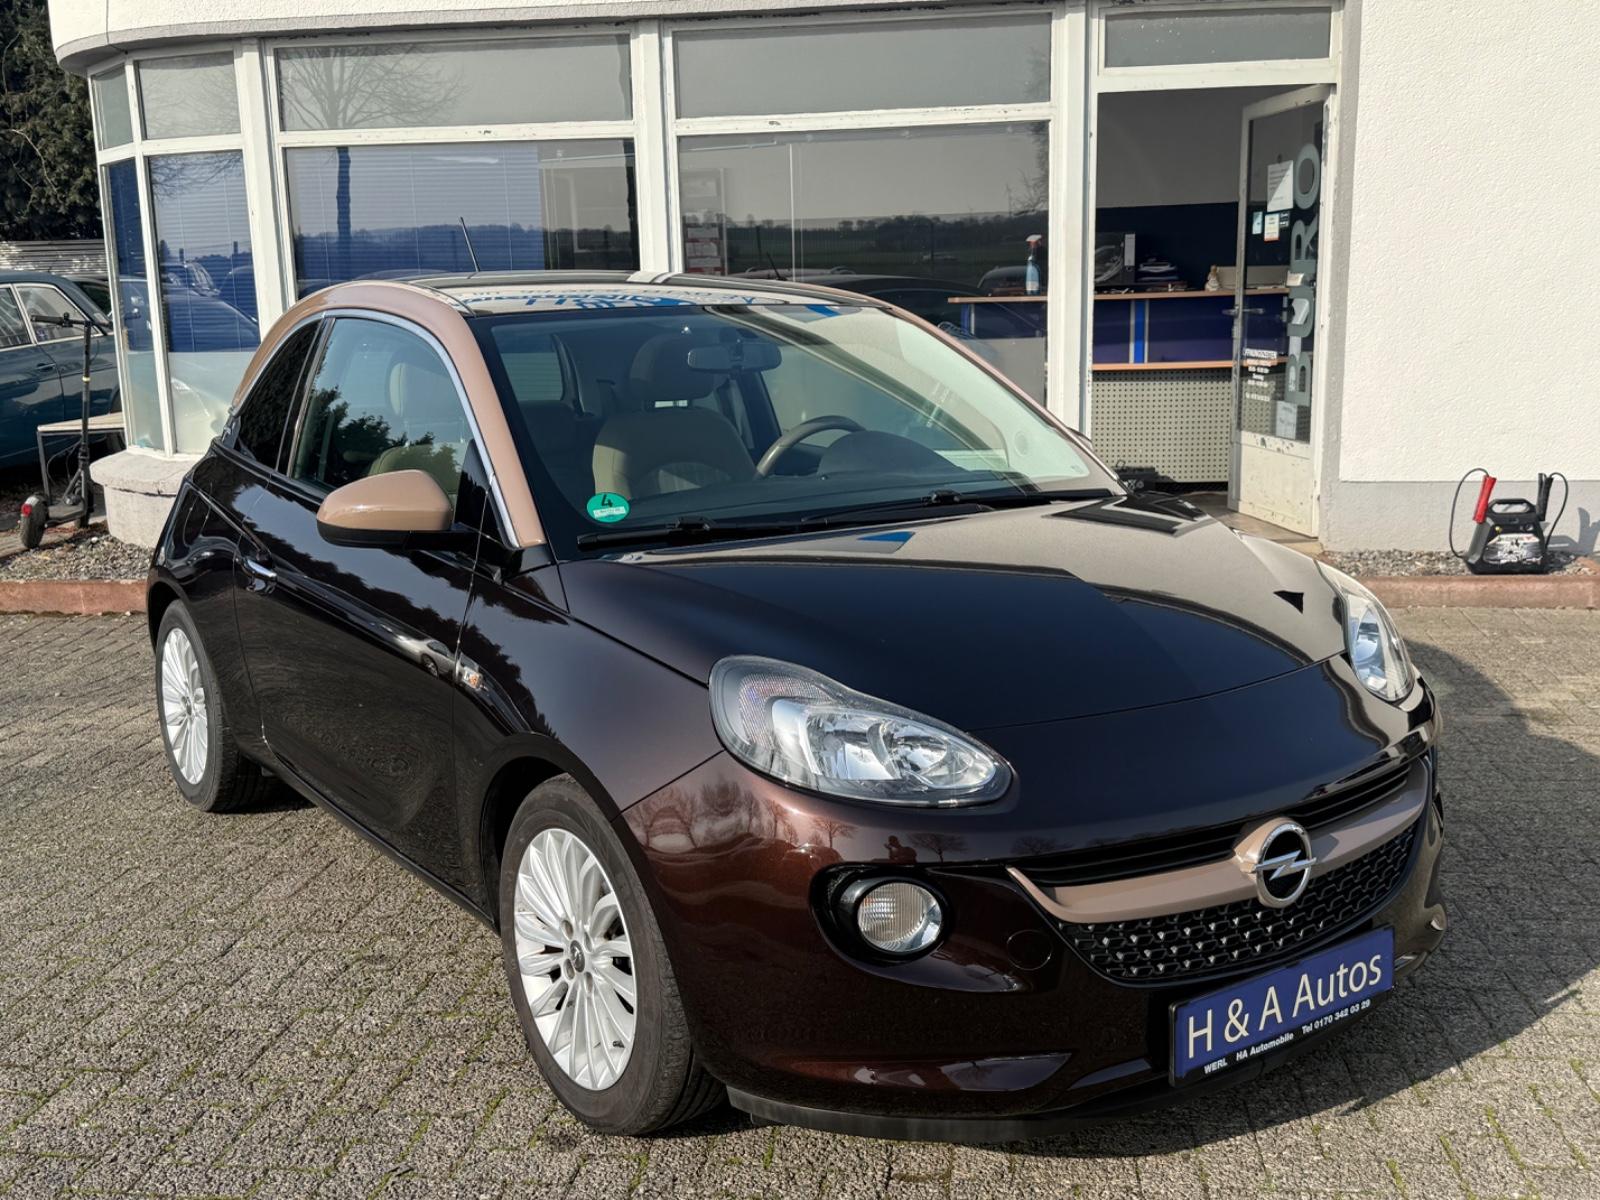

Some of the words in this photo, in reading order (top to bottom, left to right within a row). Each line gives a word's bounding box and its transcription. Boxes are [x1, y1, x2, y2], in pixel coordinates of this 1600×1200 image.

[601, 494, 613, 507] 4
[1188, 1009, 1213, 1059] H
[1224, 998, 1250, 1043] &
[1259, 985, 1283, 1032] A
[1292, 954, 1382, 1018] Autos
[1204, 1058, 1229, 1075] WERL
[1236, 1049, 1248, 1062] HA
[1250, 1032, 1294, 1056] Automobile
[1301, 1023, 1313, 1035] Tel
[1314, 1015, 1333, 1030] 0170
[1334, 1008, 1349, 1021] 342
[1350, 1004, 1360, 1016] 03
[1360, 998, 1371, 1011] 29
